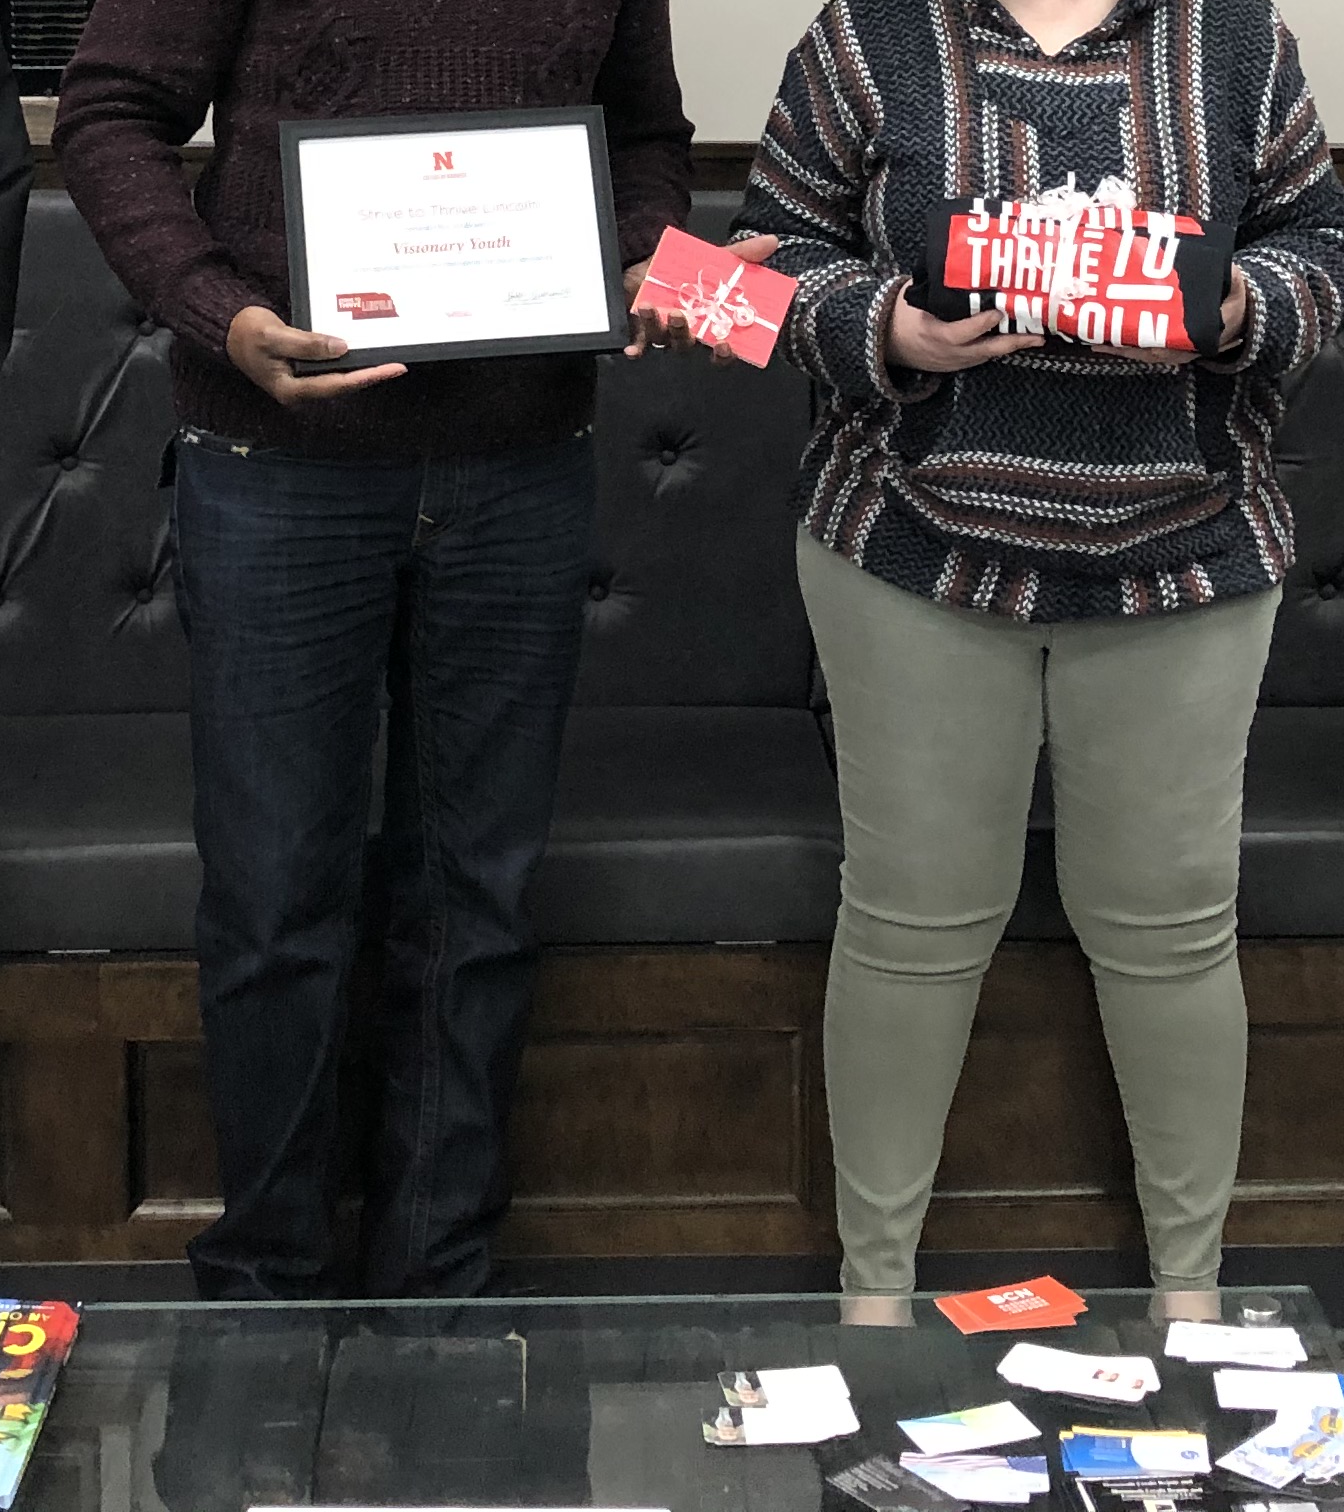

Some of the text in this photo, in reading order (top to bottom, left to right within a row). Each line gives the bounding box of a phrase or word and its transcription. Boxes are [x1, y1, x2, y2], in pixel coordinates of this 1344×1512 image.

[432, 151, 454, 171] N
[393, 235, 512, 256] Visionary Youth
